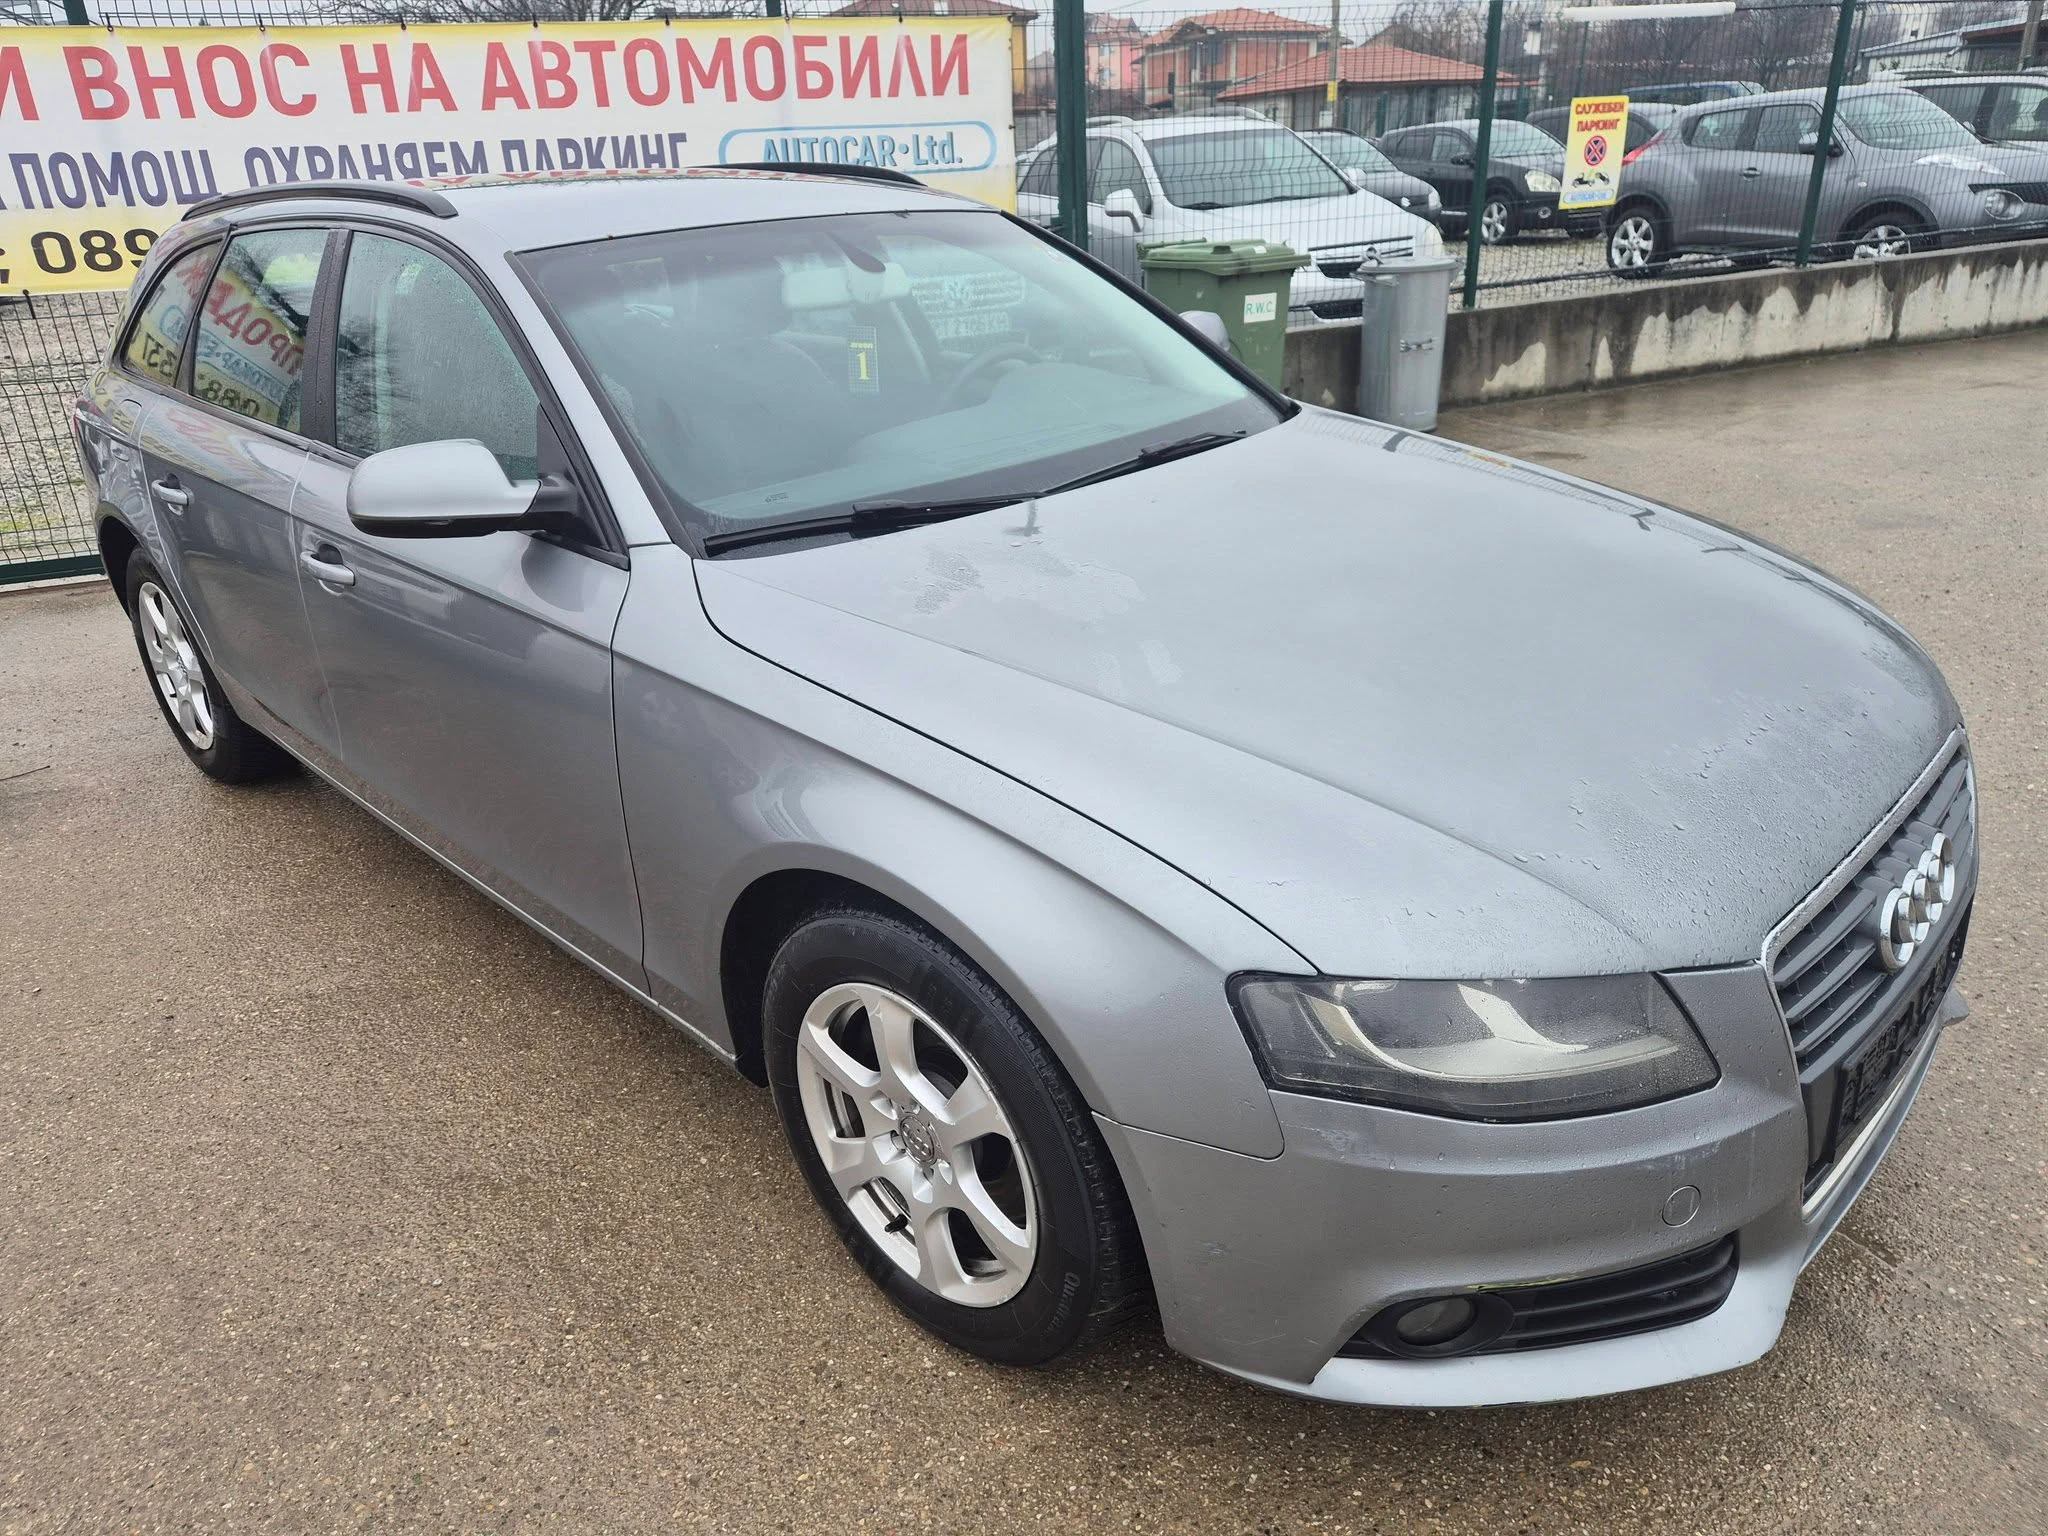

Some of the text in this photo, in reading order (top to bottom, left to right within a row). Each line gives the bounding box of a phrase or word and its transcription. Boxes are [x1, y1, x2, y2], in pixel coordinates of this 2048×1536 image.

[62, 43, 318, 121] ВНОС
[340, 42, 458, 114] НА
[481, 33, 970, 111] АВТОМОБИЛИ
[8, 149, 222, 210] ПОМОЩ
[244, 140, 489, 188] ОХРАНЯЕМ
[501, 132, 688, 173] ПАРКИНГ
[857, 352, 870, 380] 1
